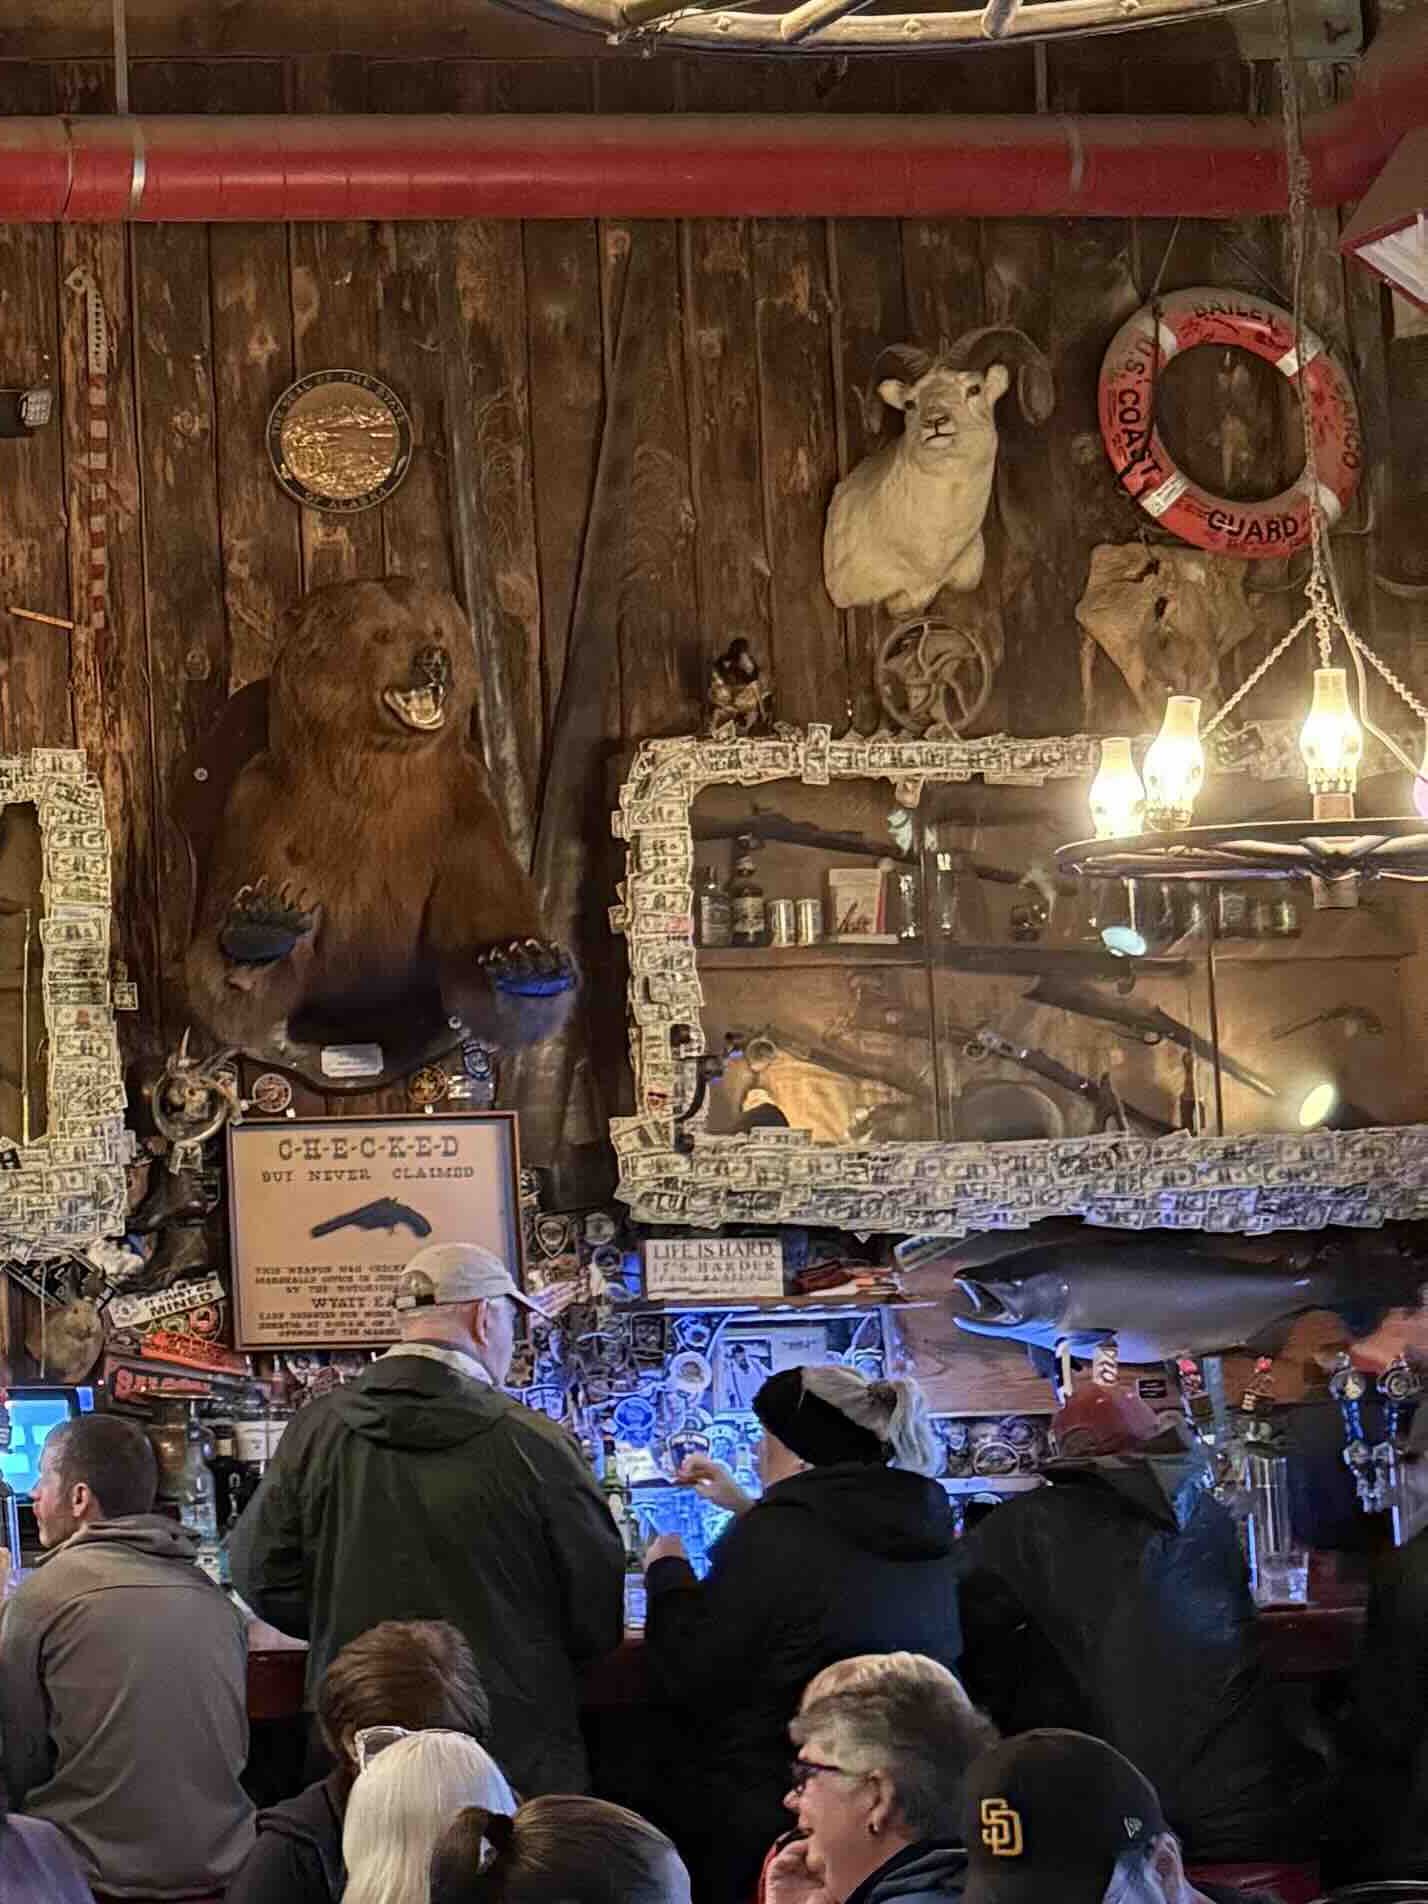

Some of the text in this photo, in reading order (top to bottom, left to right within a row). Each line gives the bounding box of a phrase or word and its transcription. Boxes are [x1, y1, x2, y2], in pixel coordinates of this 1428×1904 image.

[1117, 387, 1164, 481] COAST
[1206, 508, 1300, 545] GUARD
[261, 1165, 475, 1184] BUT NEVER CLAIMED
[653, 1243, 692, 1259] LIFE
[697, 1243, 715, 1259] IS
[311, 1296, 367, 1309] WYATT
